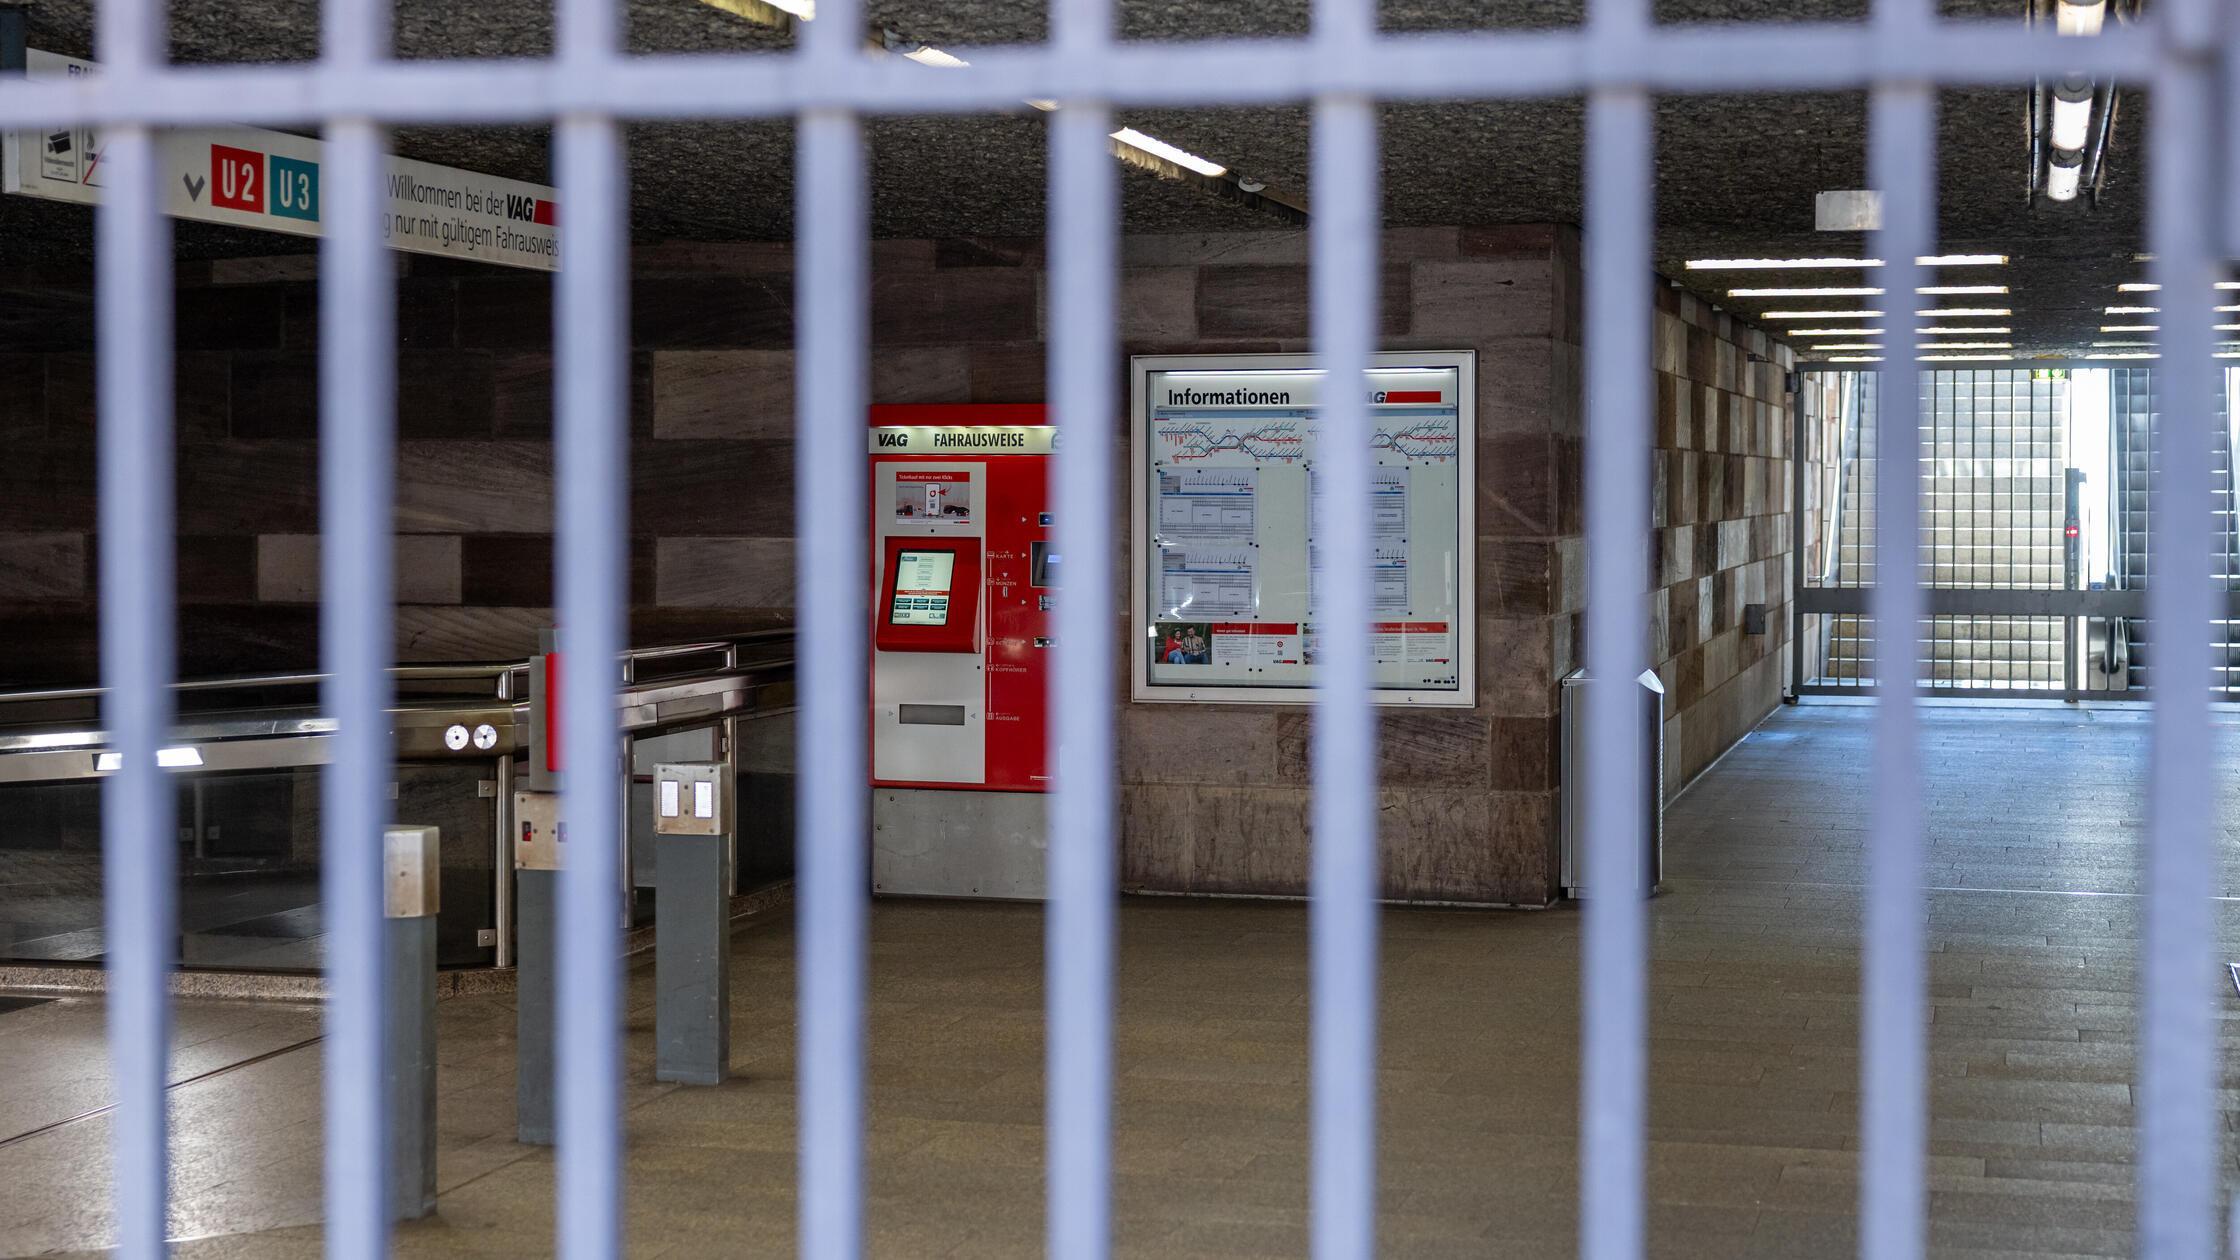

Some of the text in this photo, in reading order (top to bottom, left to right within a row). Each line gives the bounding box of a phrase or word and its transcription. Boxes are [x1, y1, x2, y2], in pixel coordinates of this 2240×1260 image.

[222, 158, 255, 202] U2
[280, 168, 310, 211] U3
[387, 173, 534, 222] Willkommen bei der VAG
[395, 214, 417, 236] nur
[419, 214, 440, 240] mit
[442, 217, 493, 251] gültigem
[495, 225, 560, 257] Fahrausweis
[1168, 387, 1290, 405] Informationen
[878, 433, 1025, 447] VAG FAHRAUSWEISE
